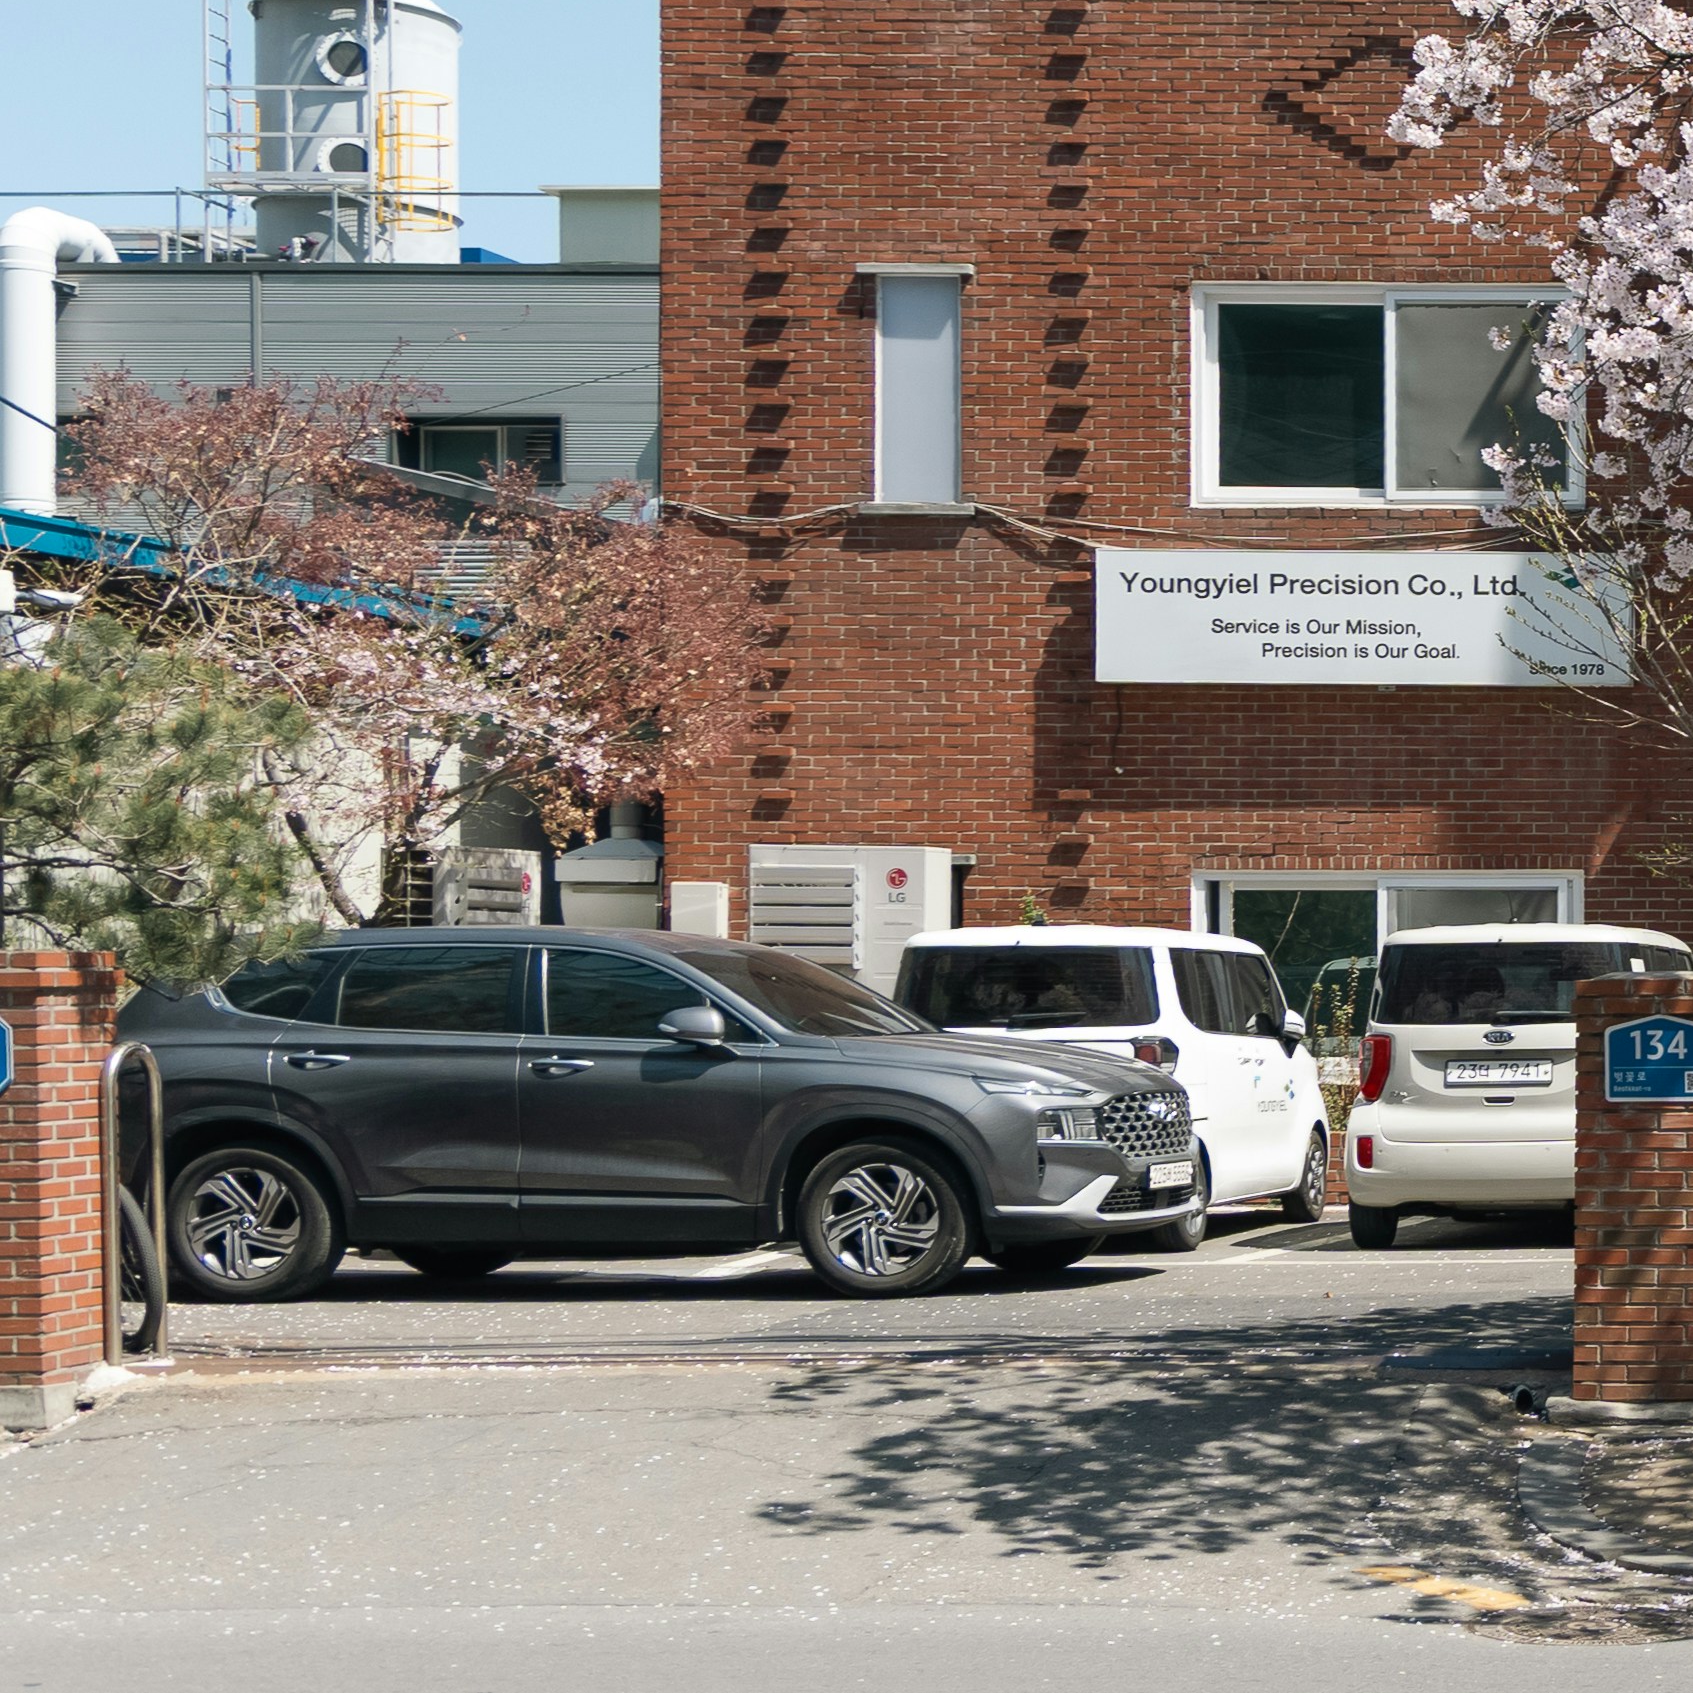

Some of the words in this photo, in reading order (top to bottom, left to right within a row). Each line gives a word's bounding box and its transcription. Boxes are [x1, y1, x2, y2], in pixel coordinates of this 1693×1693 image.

[1120, 573, 1258, 599] Youngyiel
[1270, 573, 1399, 595] Precision
[1408, 574, 1463, 600] Co.,
[1211, 619, 1280, 634] Service
[1286, 619, 1301, 634] is
[1306, 619, 1340, 634] Our
[1346, 619, 1421, 638] Mission,
[1262, 643, 1347, 658] Precision
[1354, 643, 1369, 658] is
[1374, 643, 1409, 658] Our
[1414, 643, 1461, 659] Goal.
[1571, 663, 1605, 675] 1978
[888, 892, 906, 903] LG
[1486, 1032, 1511, 1042] KIA
[1629, 1029, 1689, 1061] 134
[1498, 1062, 1541, 1078] 7941
